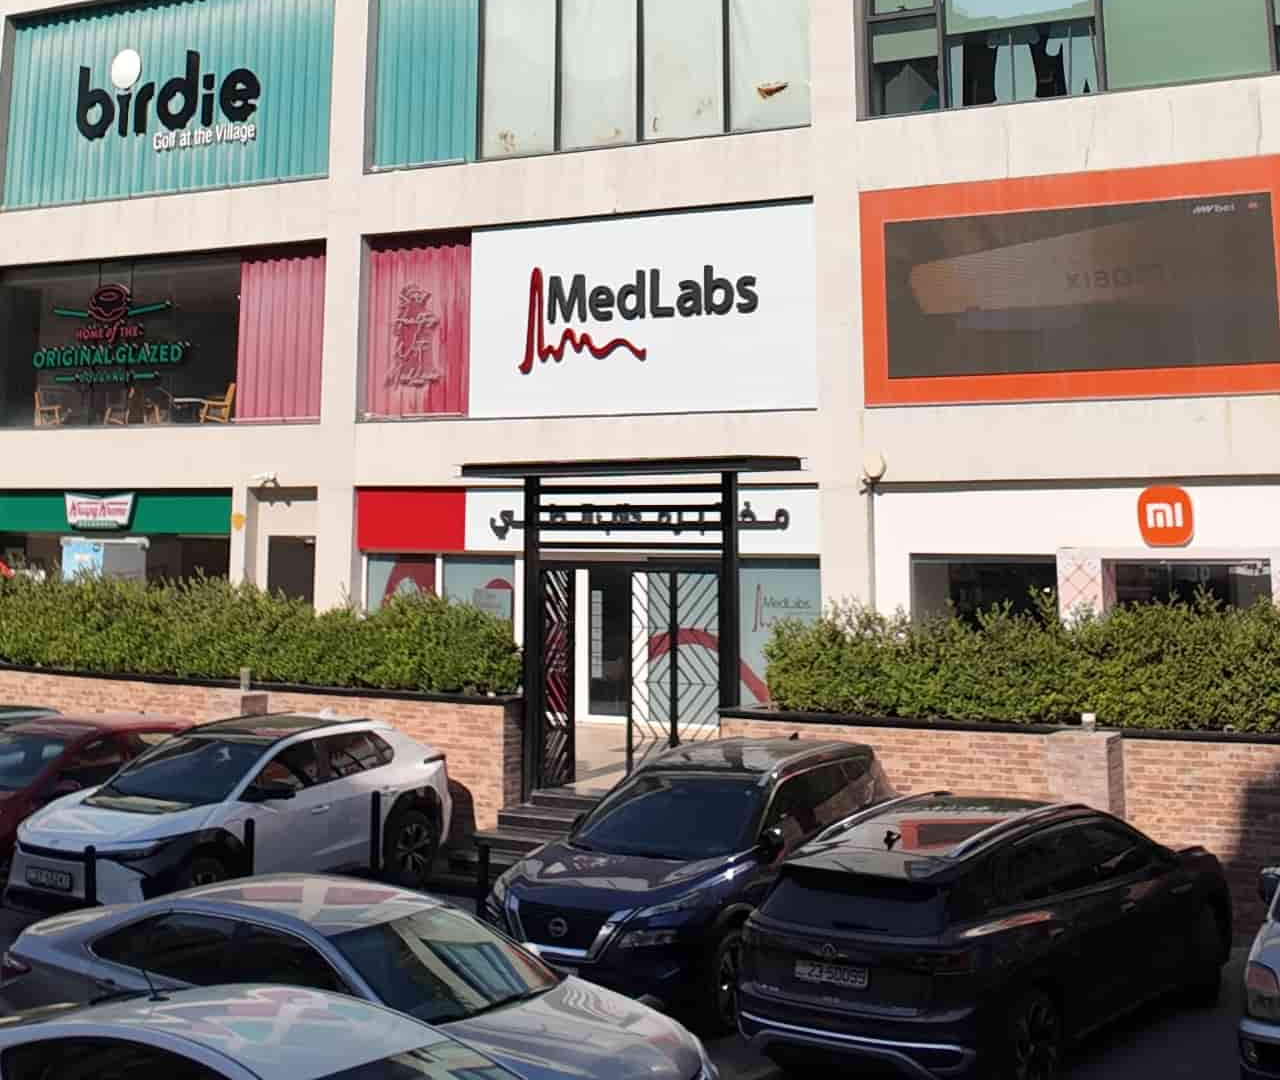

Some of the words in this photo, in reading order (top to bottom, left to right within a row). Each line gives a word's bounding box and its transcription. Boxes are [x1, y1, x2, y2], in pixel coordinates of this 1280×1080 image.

[76, 49, 261, 141] birdie
[152, 129, 177, 151] Golf
[179, 130, 192, 148] at
[193, 127, 214, 145] the
[215, 123, 256, 143] Village
[547, 265, 759, 324] MedLabs
[32, 345, 112, 368] ORIGINAL
[115, 343, 183, 364] GLAZED
